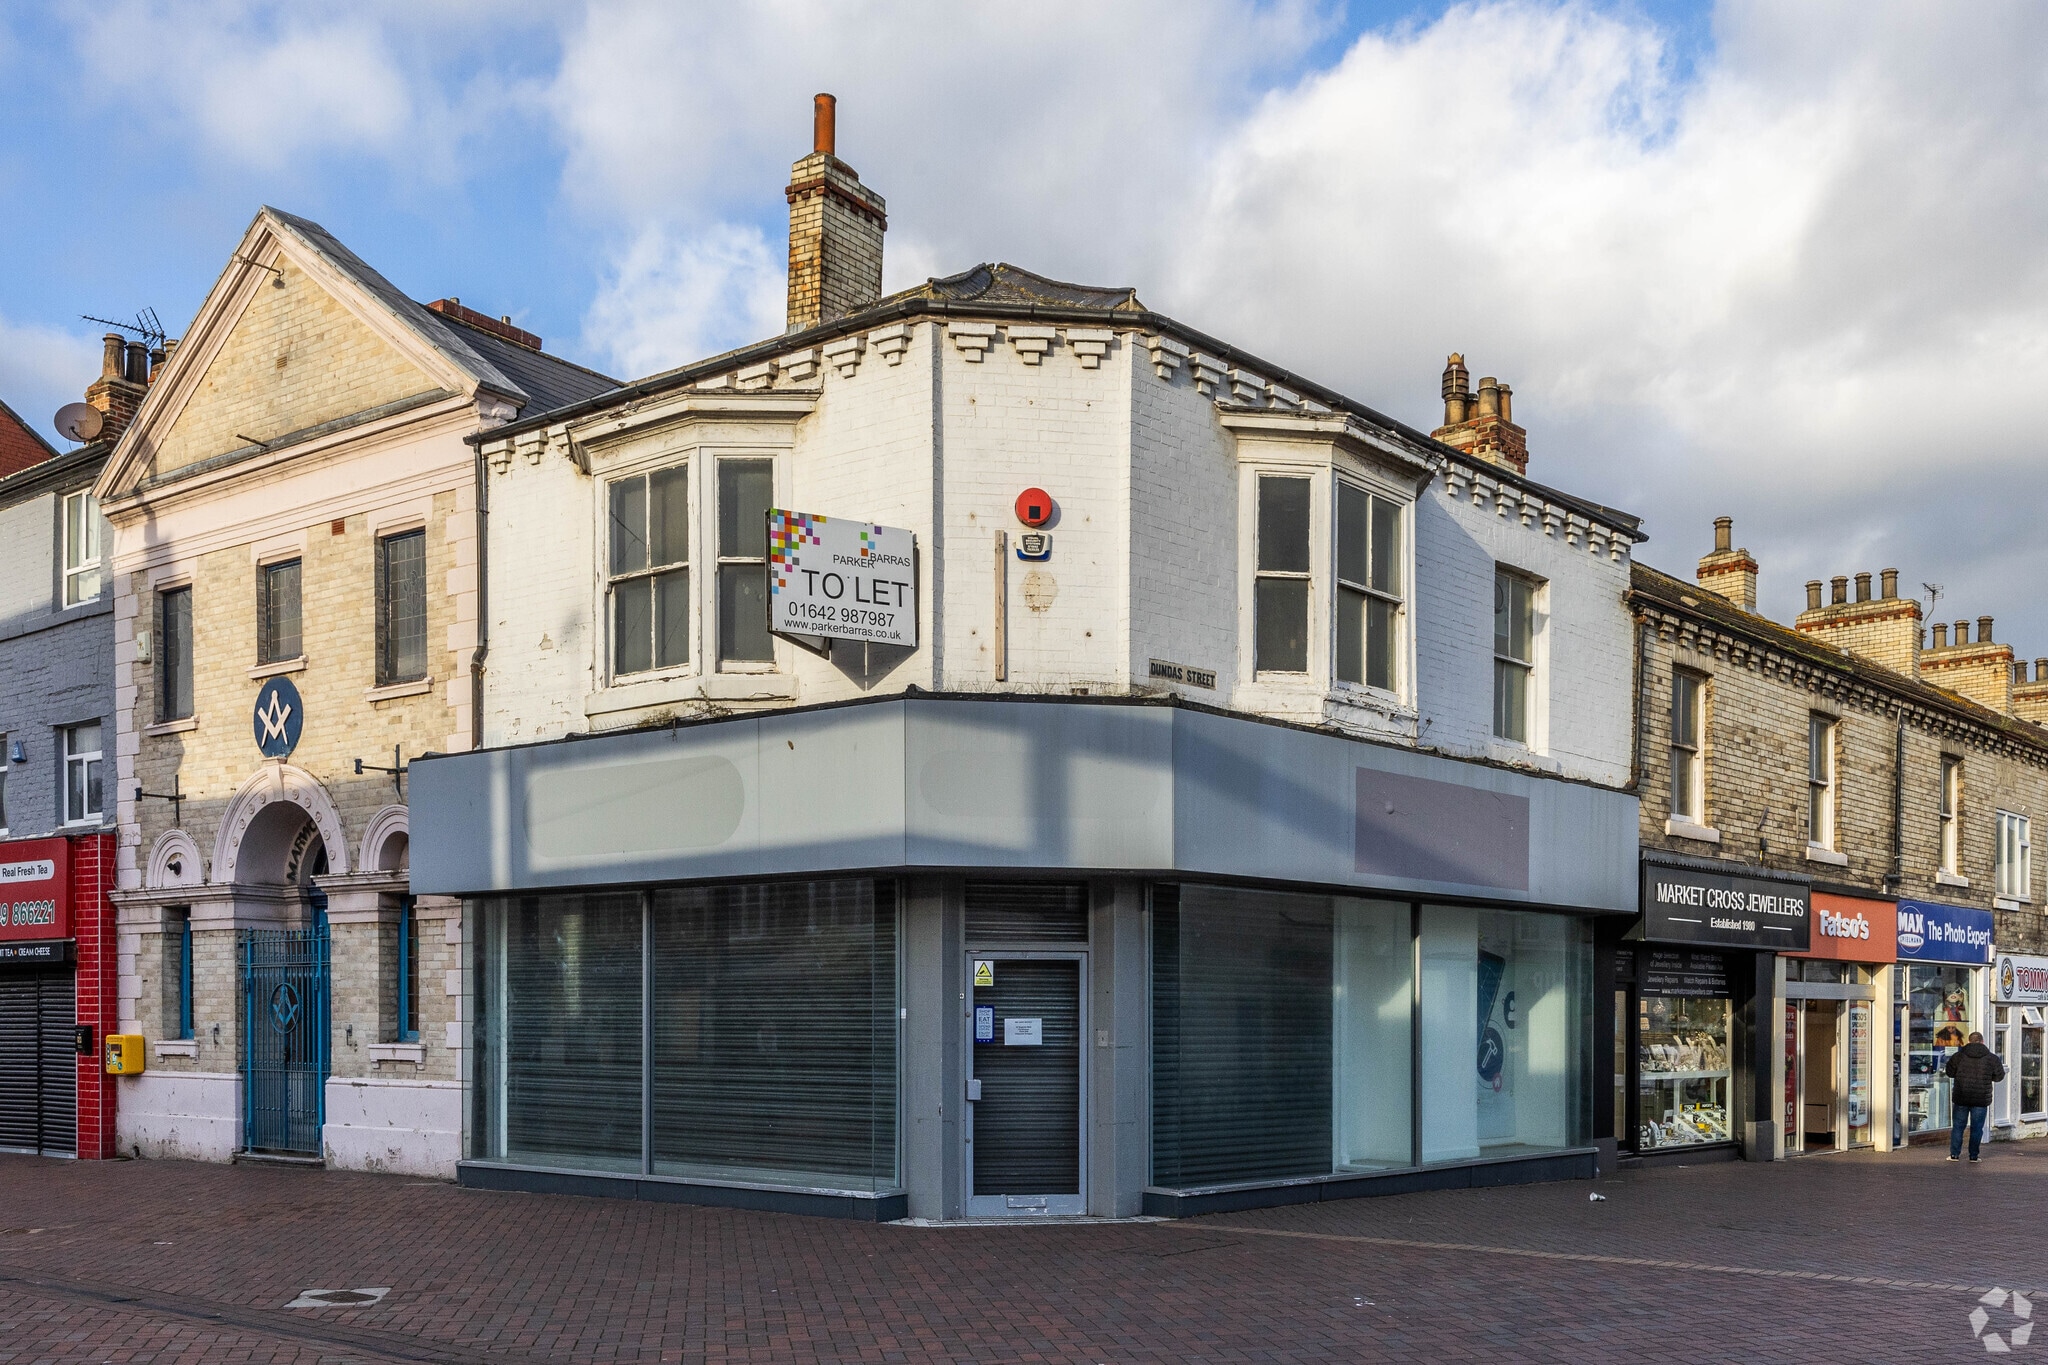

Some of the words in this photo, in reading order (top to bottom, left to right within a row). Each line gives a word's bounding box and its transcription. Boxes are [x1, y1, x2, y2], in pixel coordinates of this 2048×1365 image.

[833, 554, 875, 569] PARKER
[870, 552, 911, 567] BARRAS
[801, 569, 844, 599] TO
[855, 576, 909, 607] LET
[788, 601, 836, 621] 01642
[840, 608, 895, 627] 987987
[784, 619, 901, 640] www.parkerbarras.co.uk
[1150, 662, 1183, 680] DUNDAS
[1186, 670, 1216, 687] STREET
[2, 866, 16, 877] Real
[17, 865, 35, 877] Fresh
[37, 864, 48, 875] Tea
[1656, 882, 1705, 907] MARKET
[1706, 888, 1745, 911] CROSS
[1745, 893, 1804, 917] JEWELLERS
[12, 899, 55, 926] 866221
[1710, 917, 1741, 930] Established
[1820, 909, 1870, 940] Fatso's
[1898, 911, 1924, 934] MAX
[1927, 920, 1942, 941] The
[1944, 922, 1965, 944] Photo
[1967, 926, 1991, 950] Expert
[18, 947, 34, 957] CREAM
[35, 946, 51, 956] CHEESE
